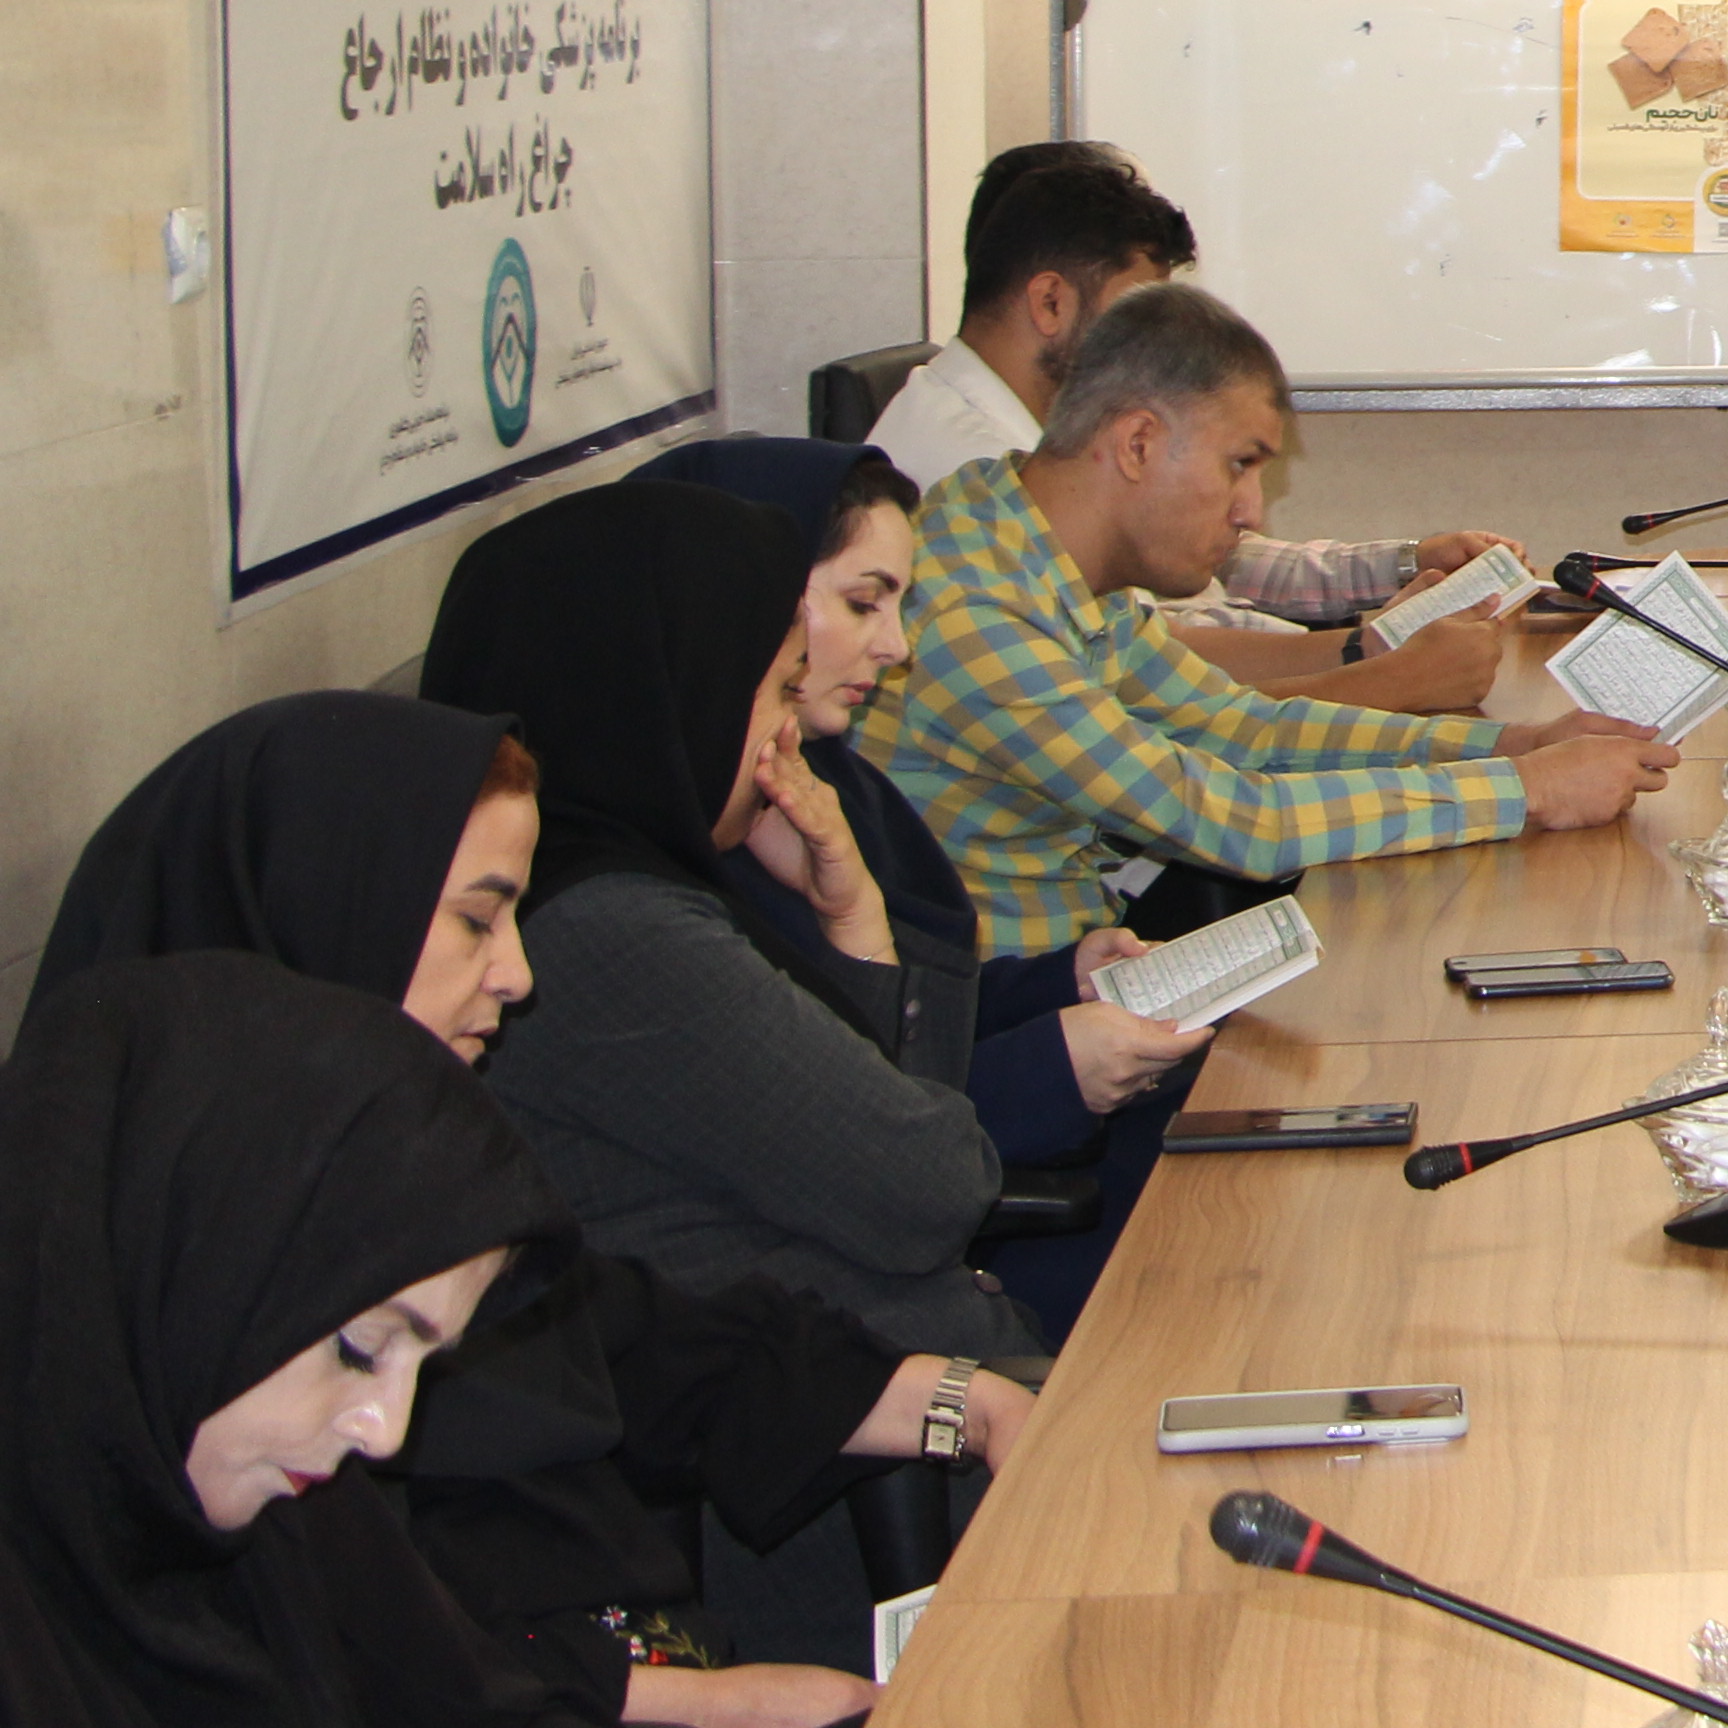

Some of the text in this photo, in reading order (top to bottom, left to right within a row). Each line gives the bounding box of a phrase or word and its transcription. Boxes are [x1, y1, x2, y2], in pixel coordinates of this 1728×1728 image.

[340, 10, 405, 122] ارجاع
[408, 6, 451, 113] نظام
[455, 39, 467, 106] و
[470, 2, 535, 102] خانواده
[540, 1, 595, 95] پزشکی
[1695, 105, 1719, 122] نان
[433, 113, 573, 218] چراغ راه سلامت
